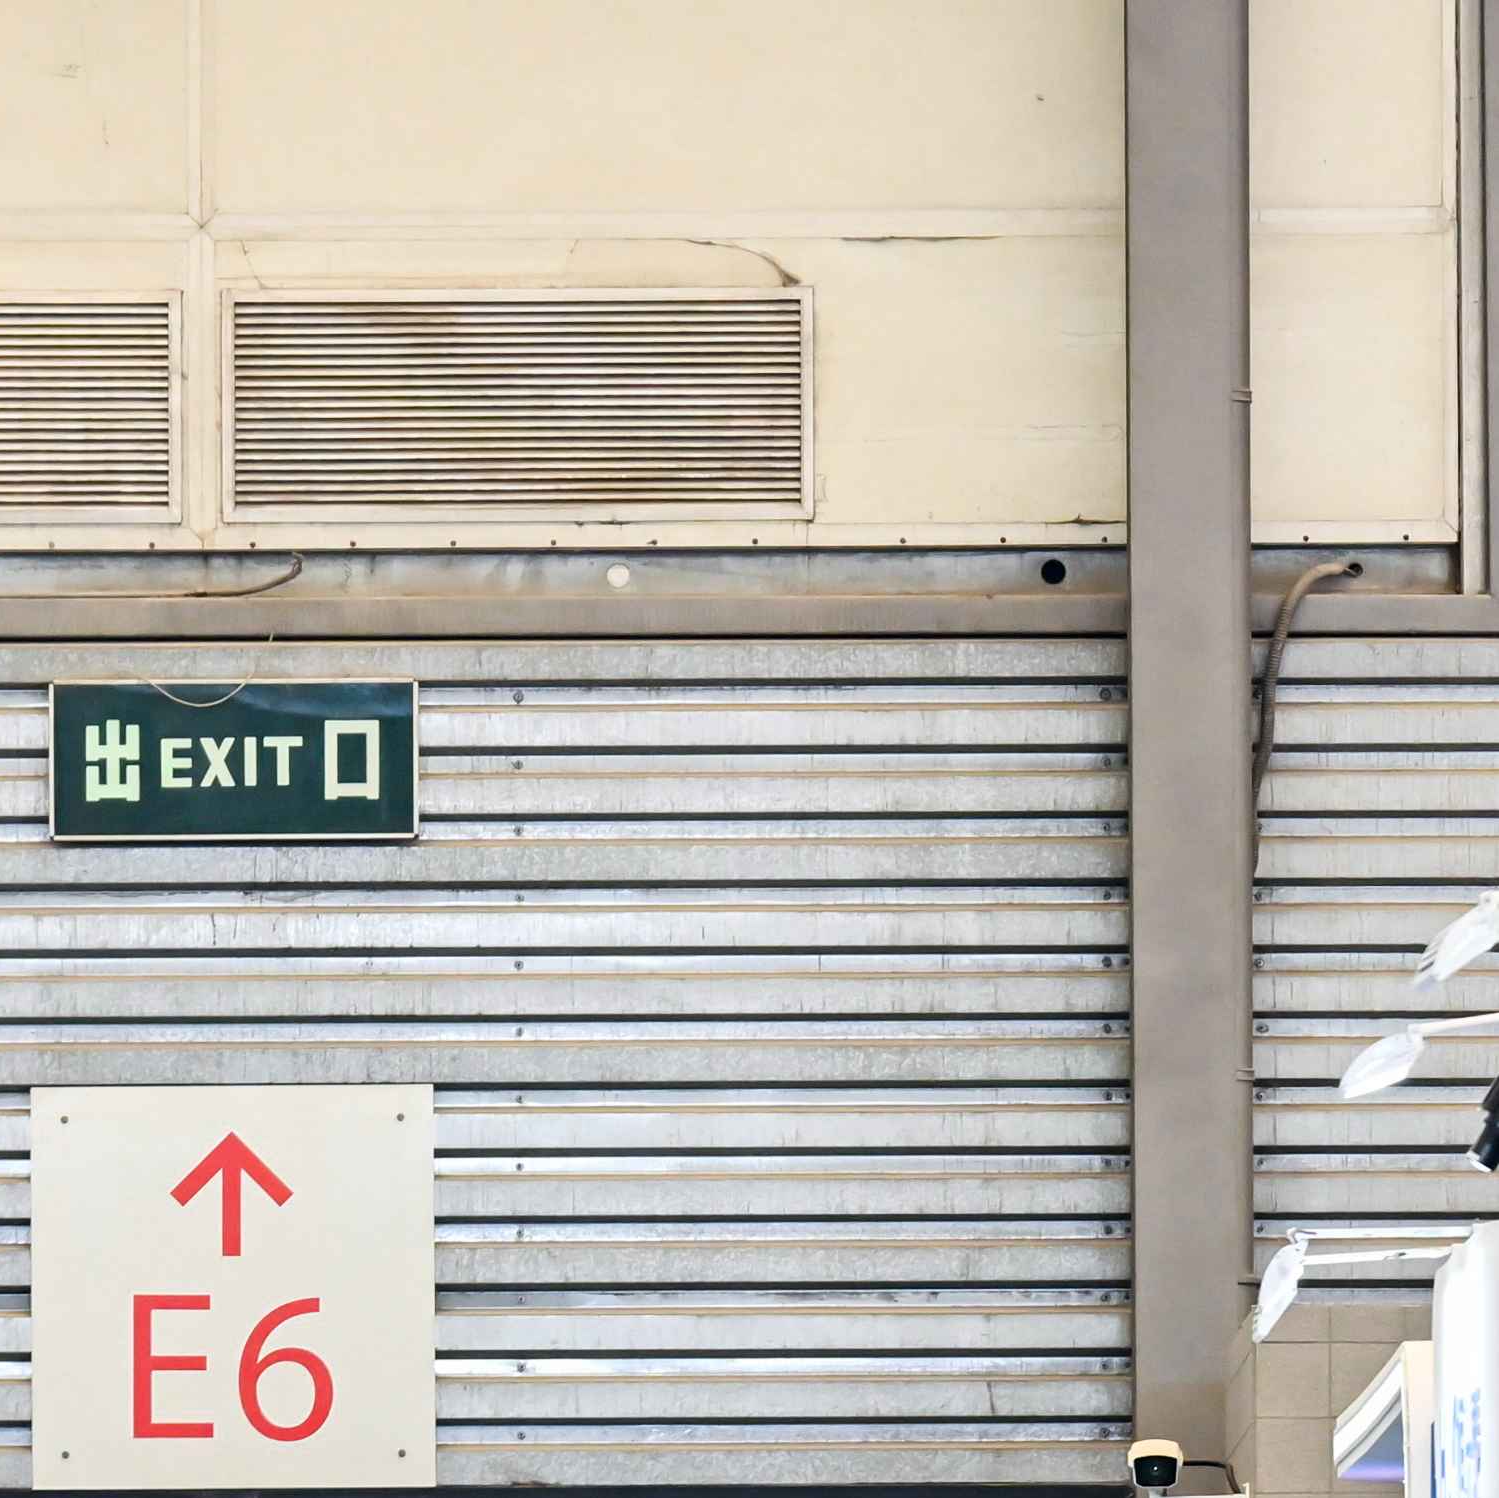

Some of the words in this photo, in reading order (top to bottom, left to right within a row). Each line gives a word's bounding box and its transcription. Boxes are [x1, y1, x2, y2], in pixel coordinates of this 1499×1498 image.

[84, 718, 141, 803] 出
[159, 736, 303, 789] EXIT
[322, 718, 381, 801] 口
[132, 1293, 334, 1442] E6
